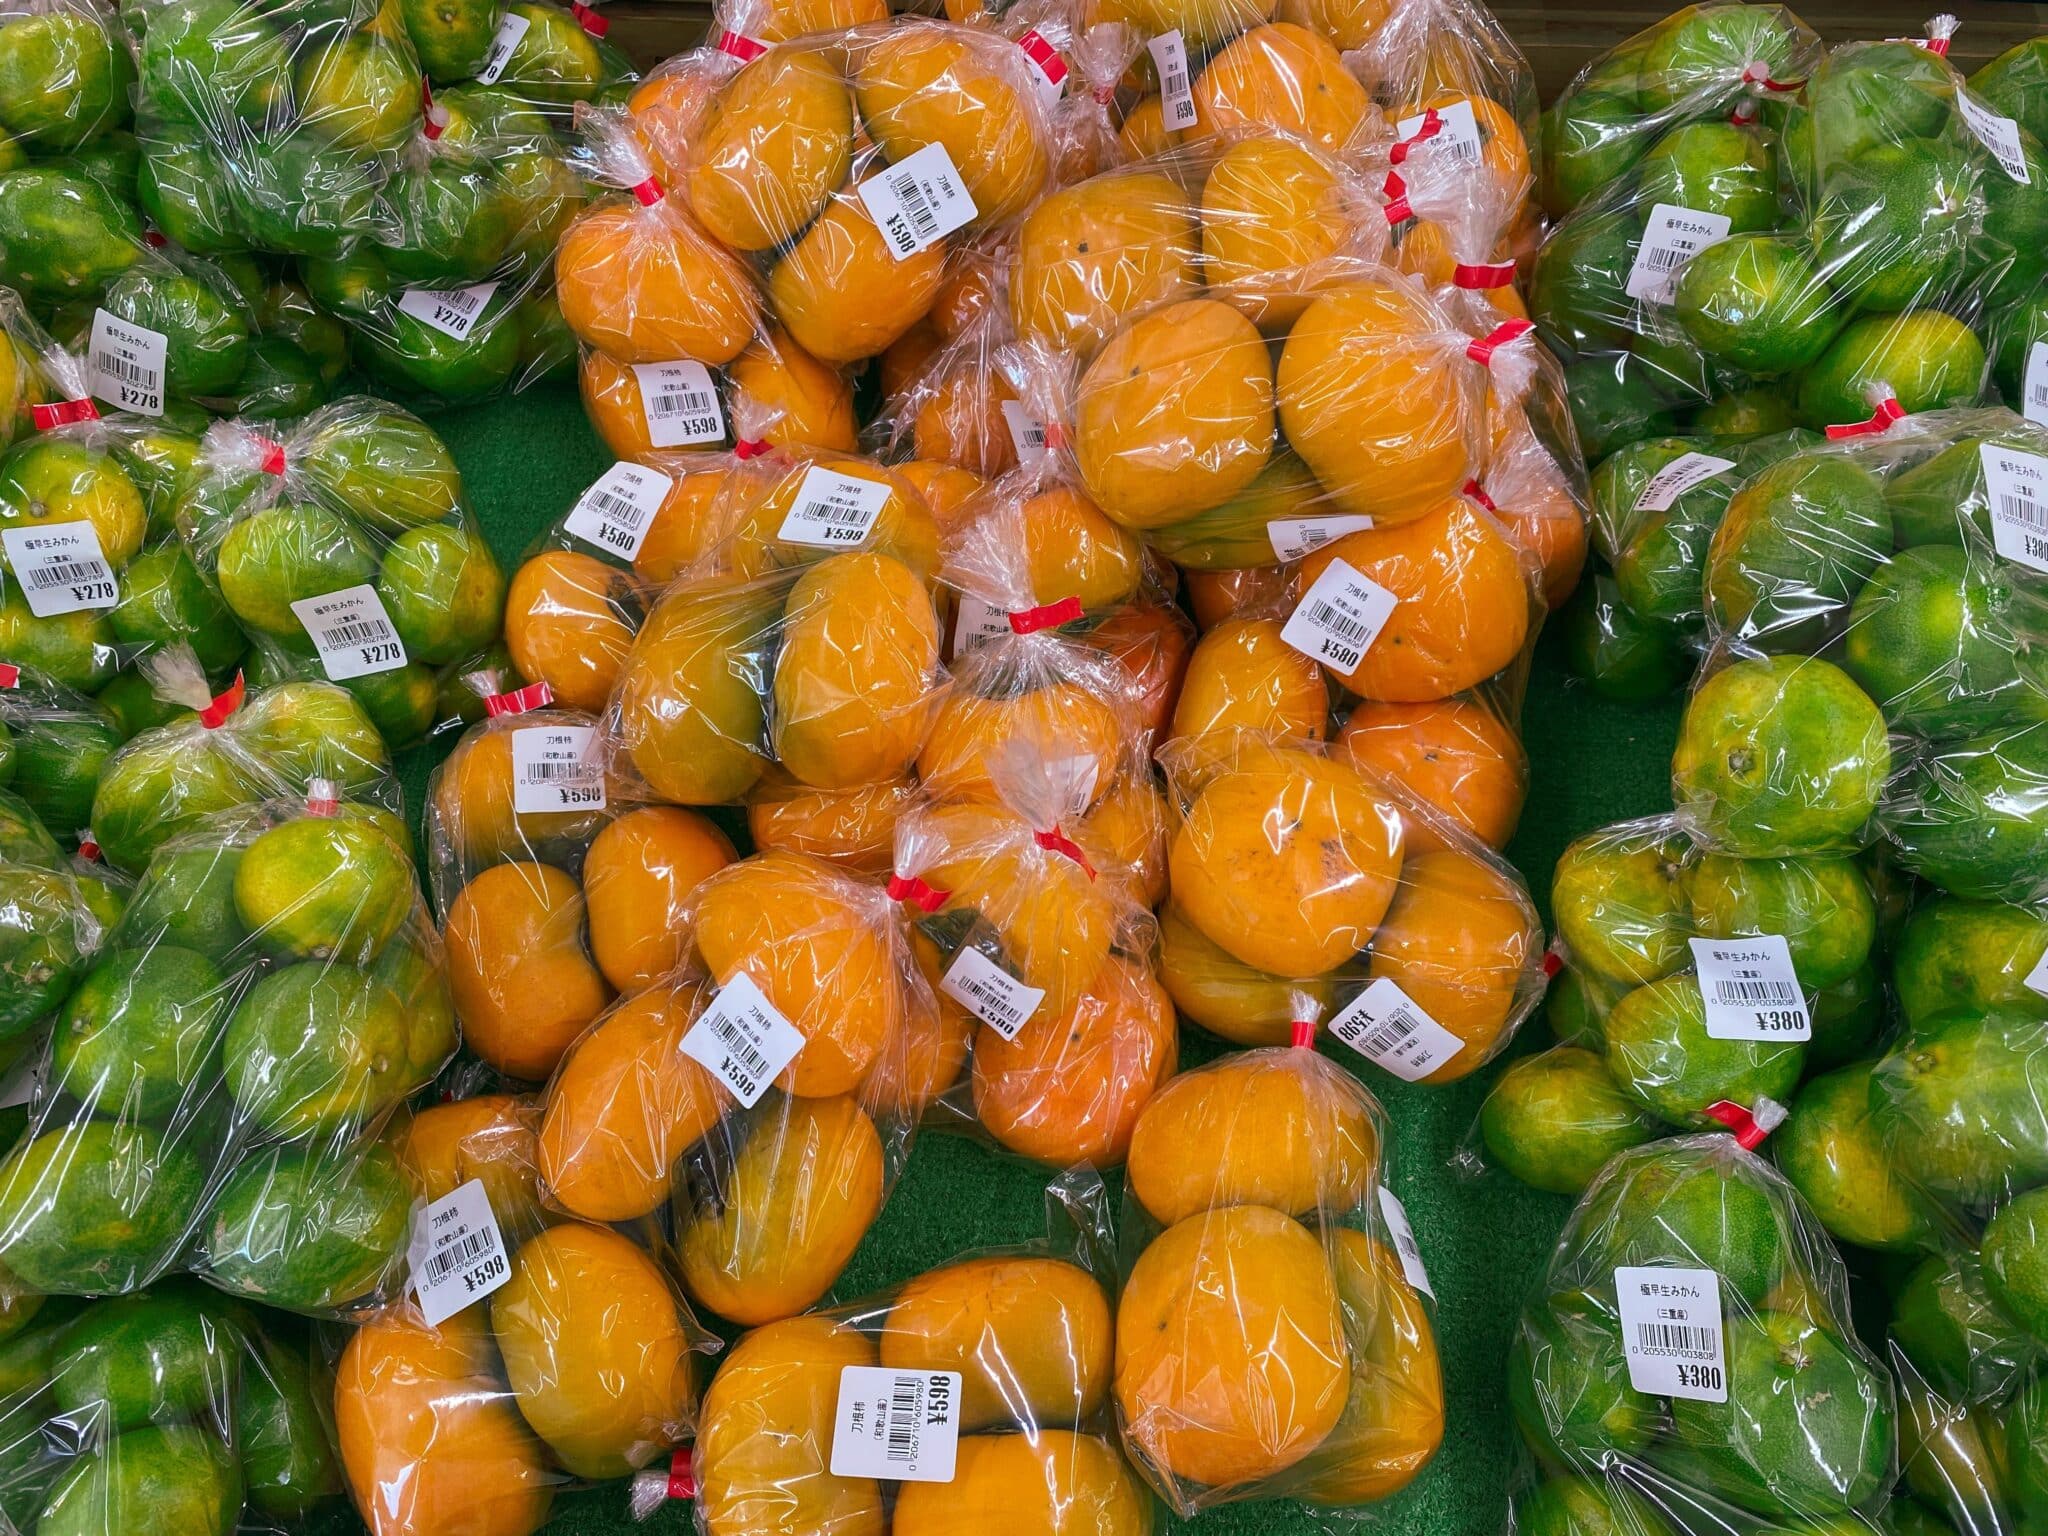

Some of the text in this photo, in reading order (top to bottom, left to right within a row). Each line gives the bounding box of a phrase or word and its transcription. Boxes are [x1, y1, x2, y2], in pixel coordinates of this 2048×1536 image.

[1176, 100, 1193, 120] ¥598
[886, 212, 916, 252] ¥598
[434, 305, 467, 331] ¥278
[121, 386, 158, 409] ¥278
[682, 417, 717, 436] ¥598
[598, 522, 635, 551] ¥580
[824, 527, 864, 541] ¥598
[2025, 535, 2048, 561] ¥380
[71, 582, 114, 601] ¥278
[361, 642, 400, 664] ¥278
[1320, 638, 1359, 667] ¥580
[546, 736, 572, 744] 刀根柿
[748, 1004, 772, 1031] 刀根柿
[979, 1005, 1014, 1035] ¥580
[1338, 1008, 1375, 1041] ¥598
[1755, 1010, 1804, 1031] ¥380
[720, 1056, 756, 1097] ¥598
[431, 1206, 459, 1229] 刀根柿
[463, 1254, 505, 1293] ¥598
[1640, 1283, 1700, 1298] 極早生みかん
[1643, 1347, 1677, 1358] 205530
[1677, 1364, 1721, 1390] ¥380
[914, 1381, 925, 1418] 605980
[927, 1375, 951, 1426] ¥598
[851, 1401, 866, 1433] 刀根柿
[910, 1421, 921, 1459] 206710
